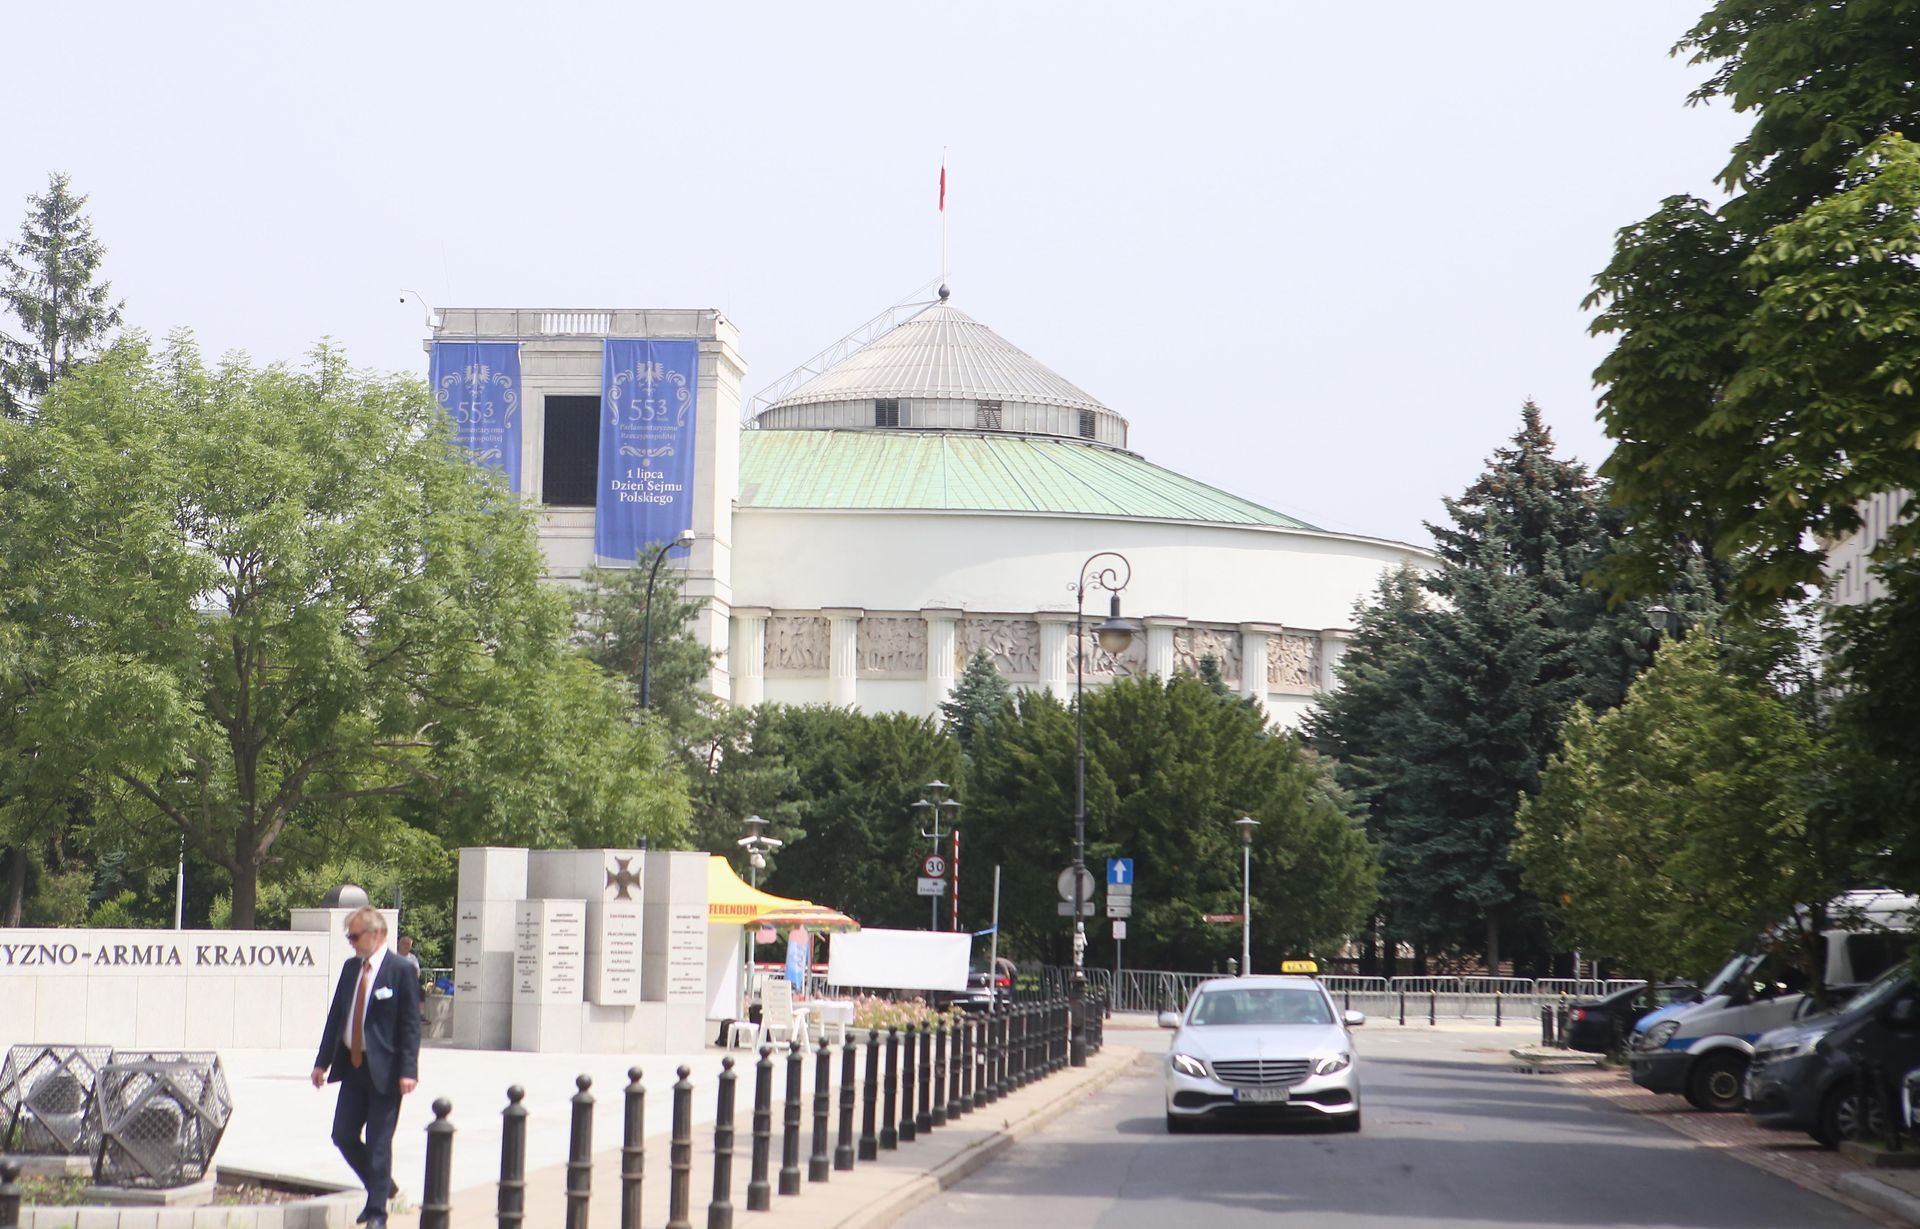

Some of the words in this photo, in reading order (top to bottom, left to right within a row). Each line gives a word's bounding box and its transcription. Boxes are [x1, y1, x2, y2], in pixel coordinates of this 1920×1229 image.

[457, 402, 494, 423] 553
[628, 399, 667, 421] 553
[626, 469, 633, 479] 1
[637, 467, 664, 481] lipca
[611, 480, 644, 491] Dzień
[647, 481, 682, 494] Sejmu
[620, 491, 673, 505] Polskiego
[928, 861, 944, 872] 30
[708, 904, 758, 916] FERENDUM
[195, 944, 316, 967] KRAJOWA
